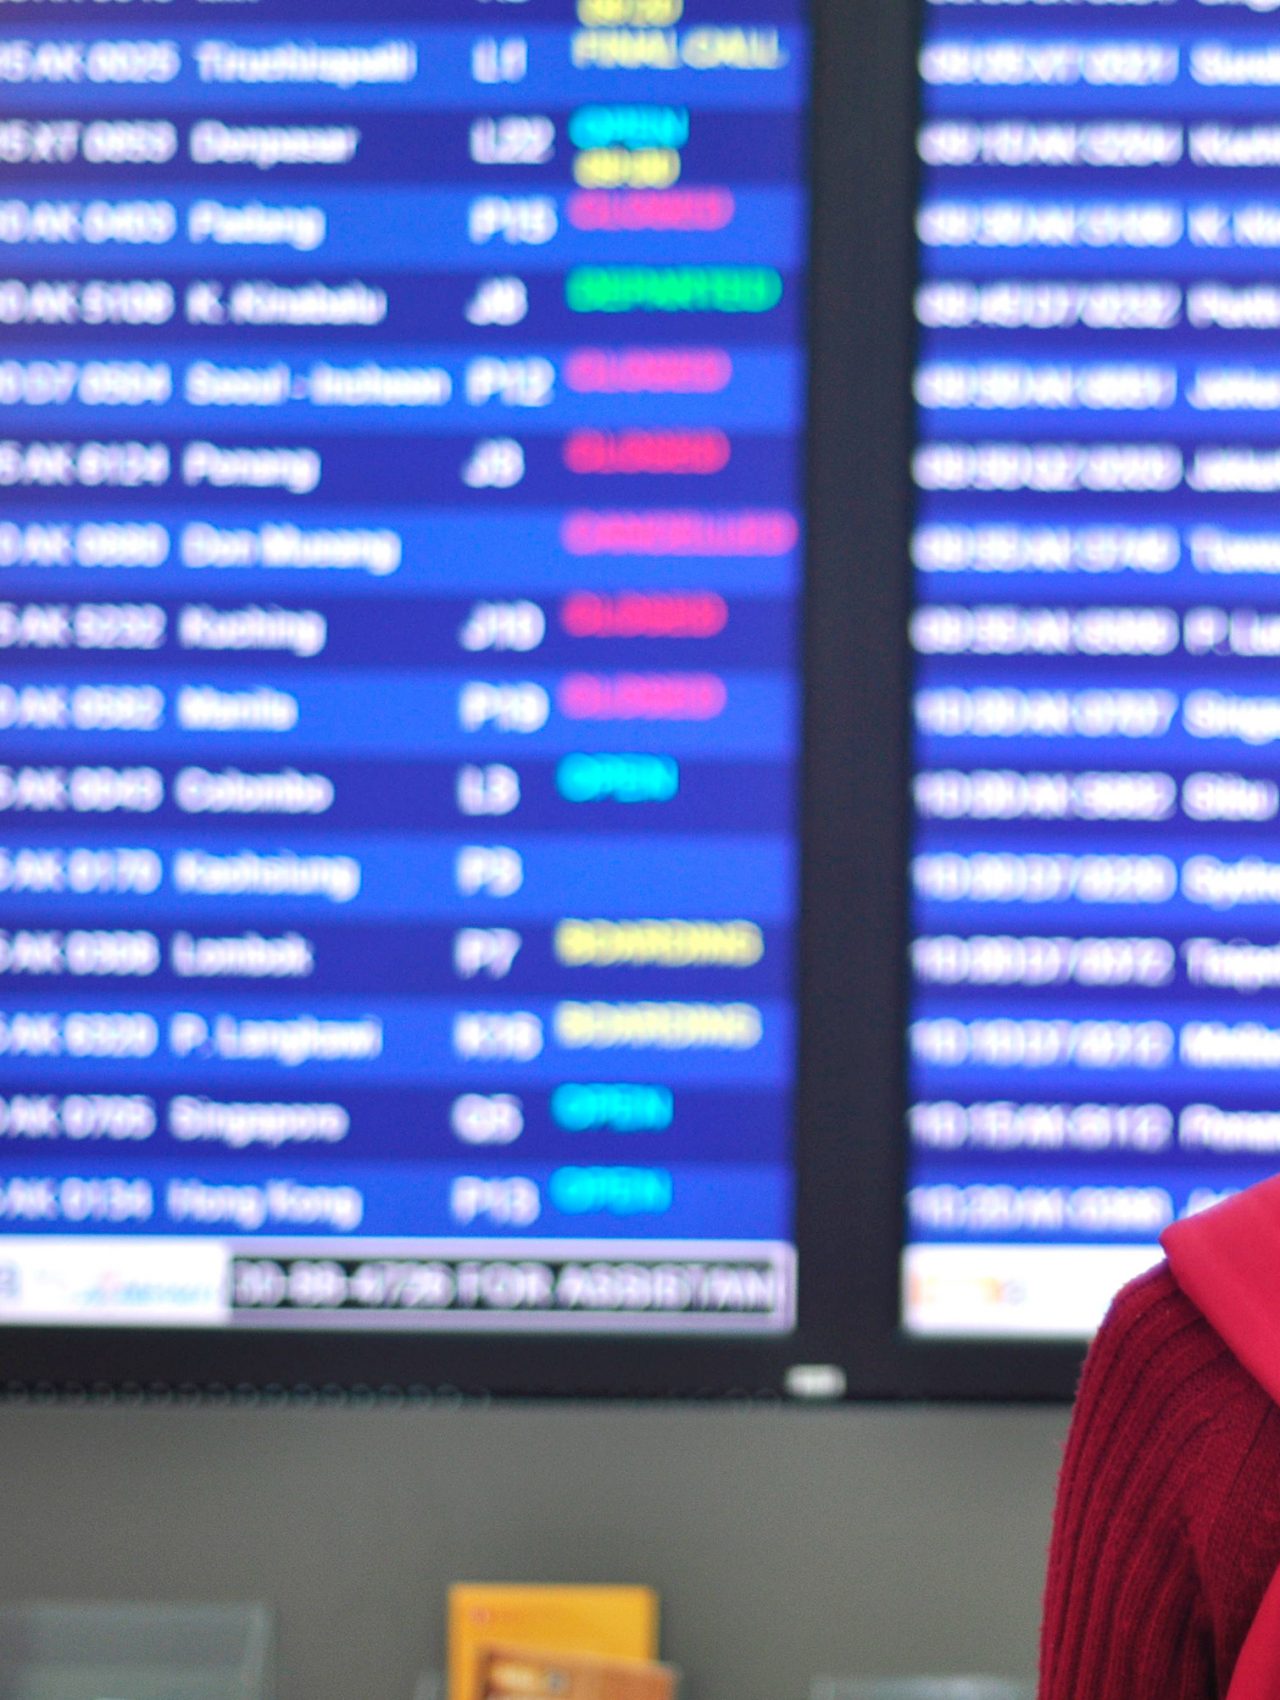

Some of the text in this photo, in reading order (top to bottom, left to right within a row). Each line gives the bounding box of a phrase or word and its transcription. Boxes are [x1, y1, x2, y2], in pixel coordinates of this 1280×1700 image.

[573, 28, 676, 68] FINAL
[681, 28, 782, 68] CALL
[556, 921, 762, 965] BOARDING
[556, 1004, 760, 1047] BOARDING
[458, 1263, 553, 1308] FOR
